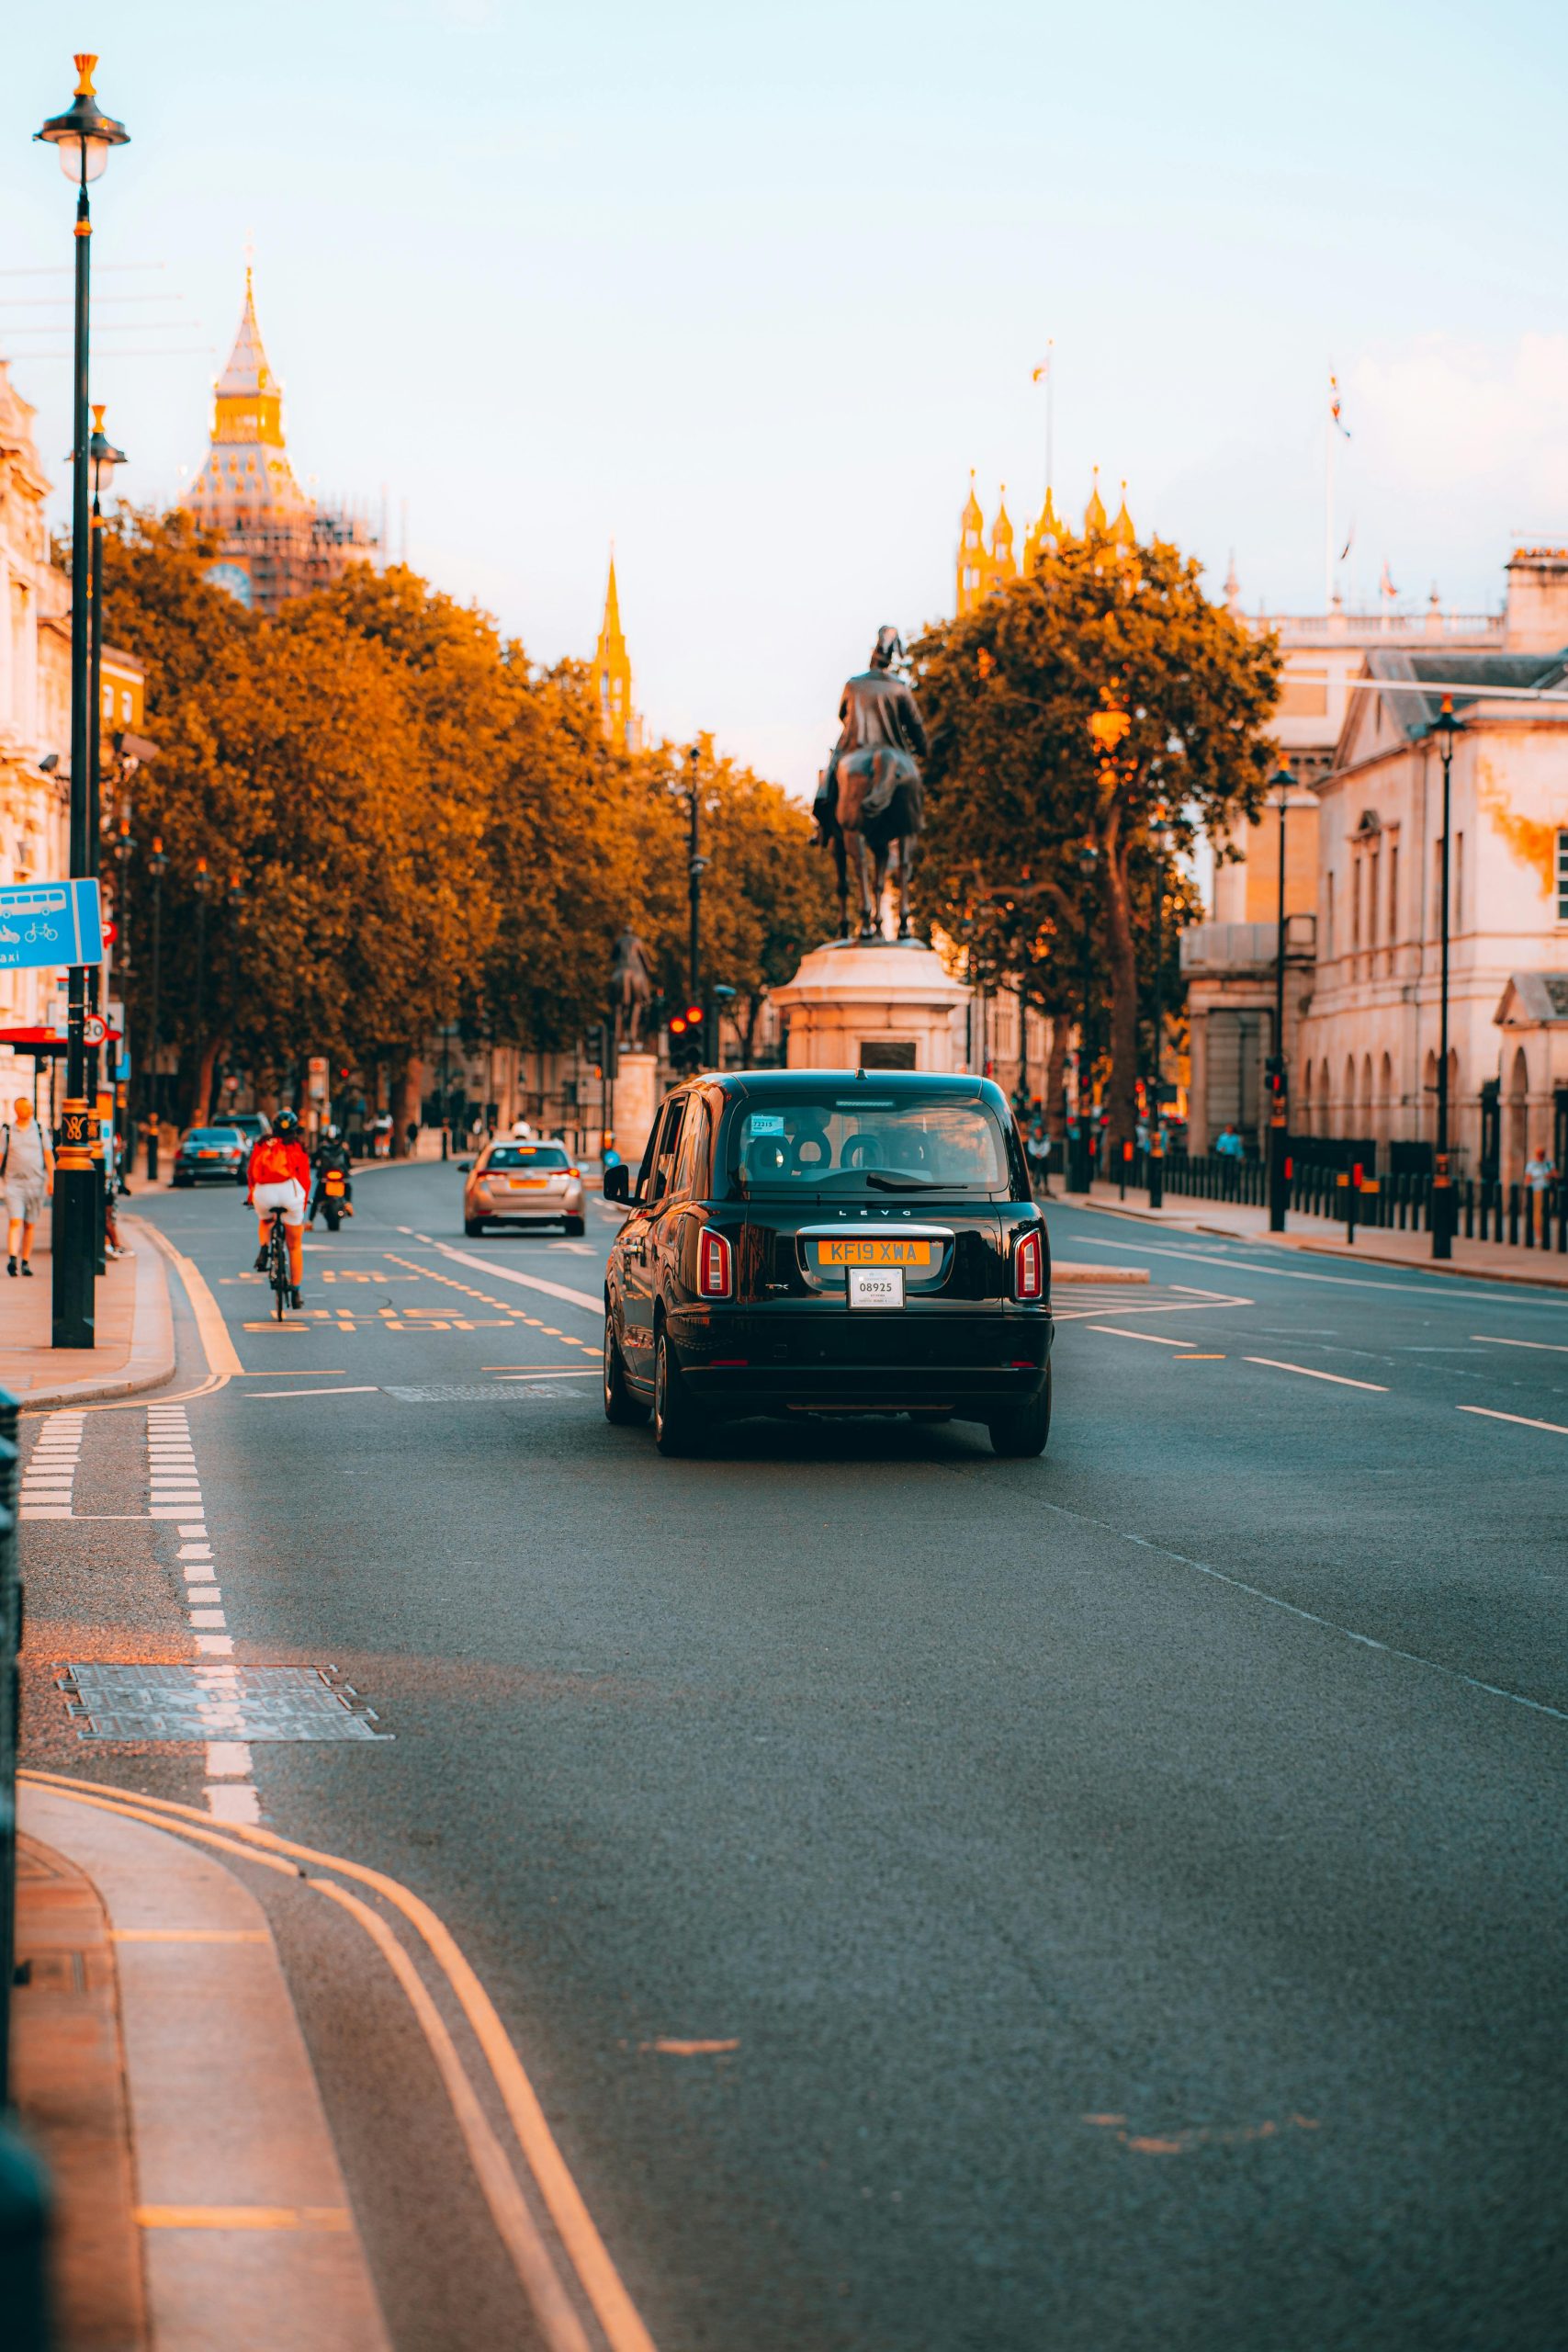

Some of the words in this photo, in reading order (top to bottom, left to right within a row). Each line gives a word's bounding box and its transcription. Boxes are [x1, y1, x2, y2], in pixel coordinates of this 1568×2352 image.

[0, 950, 19, 963] axi
[831, 1243, 874, 1261] KF19
[880, 1243, 917, 1261] XWA
[860, 1282, 892, 1292] 08925
[243, 1320, 514, 1332] STOP
